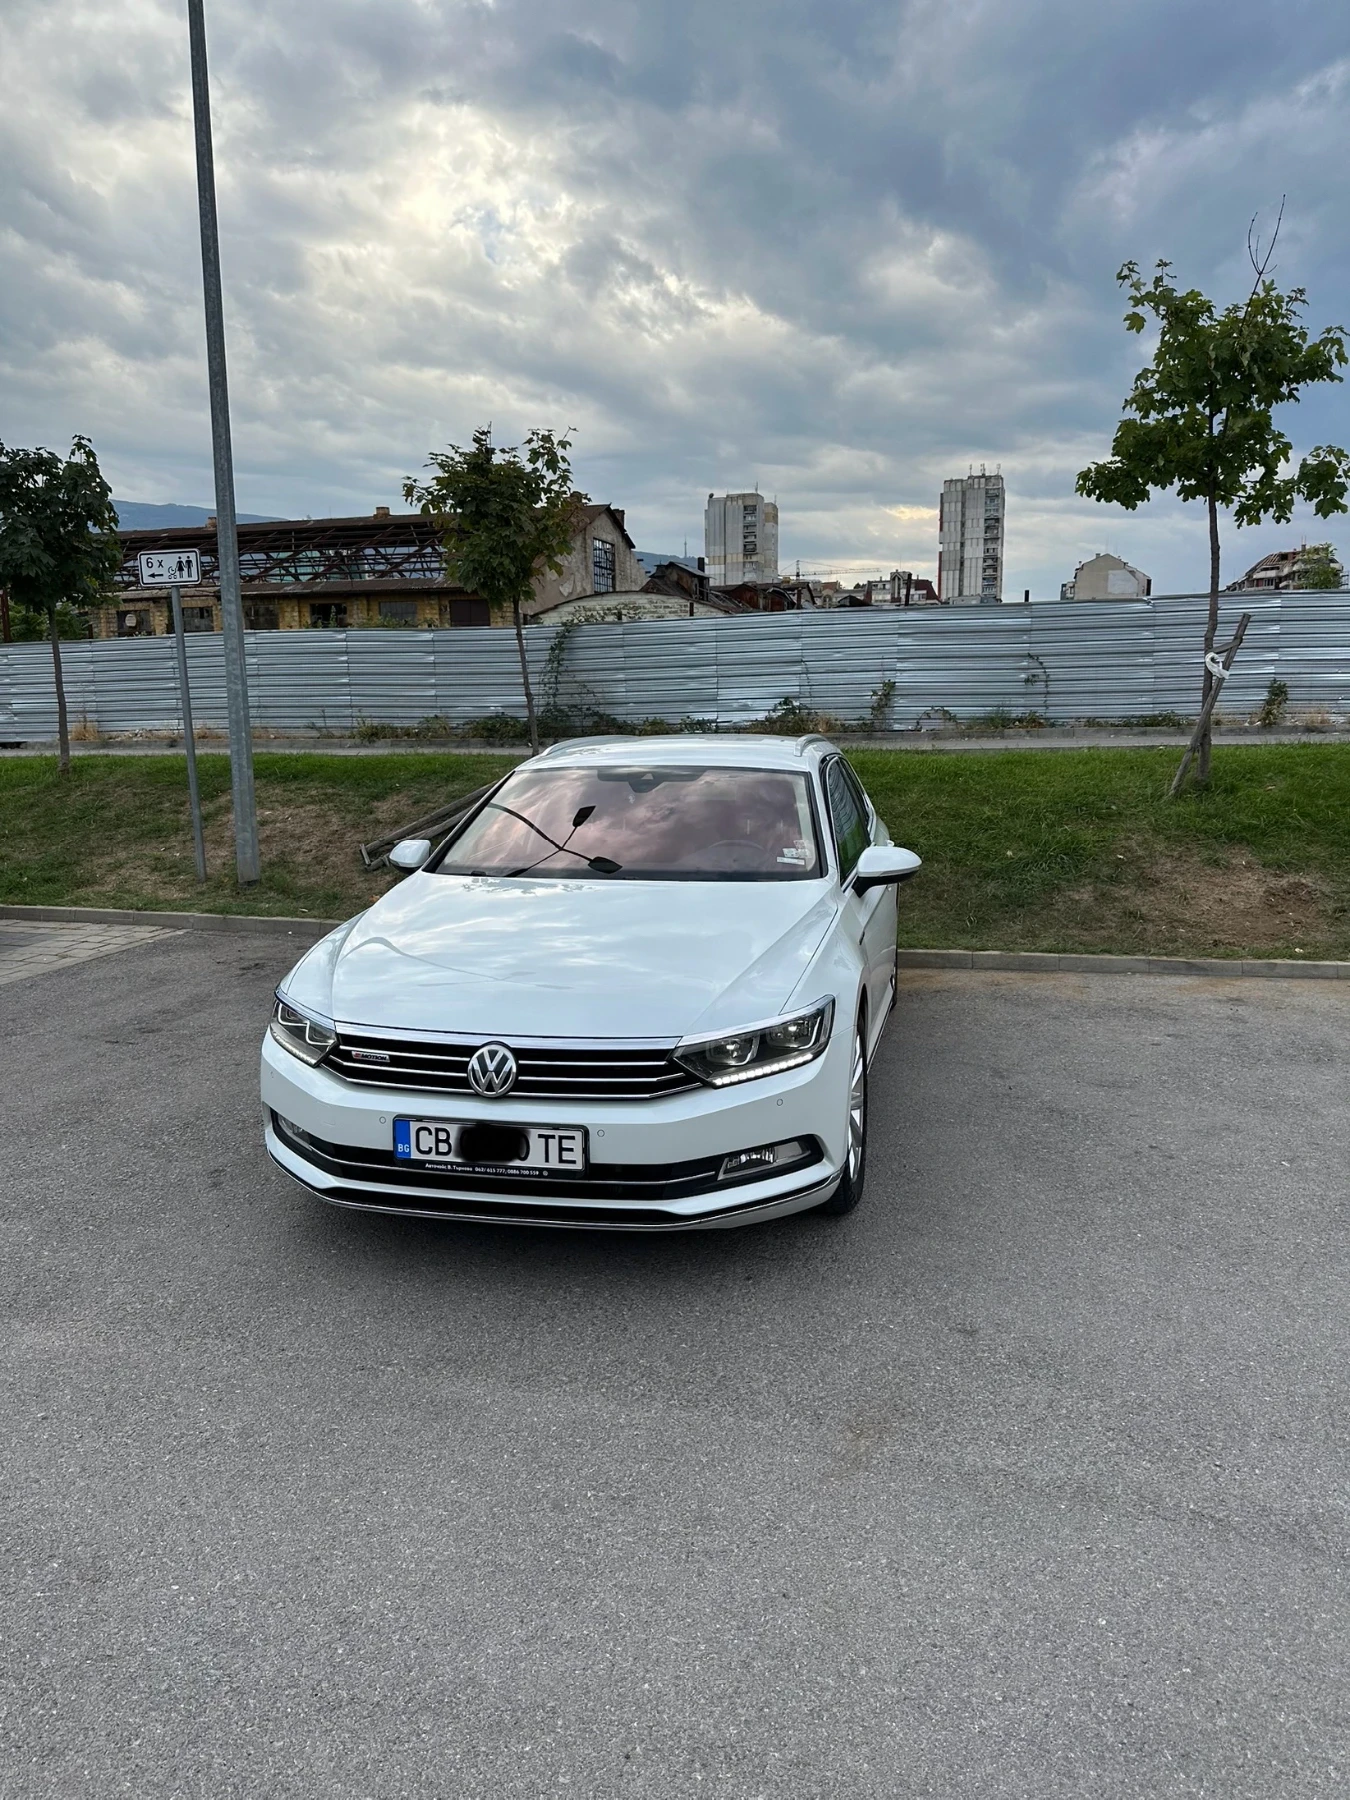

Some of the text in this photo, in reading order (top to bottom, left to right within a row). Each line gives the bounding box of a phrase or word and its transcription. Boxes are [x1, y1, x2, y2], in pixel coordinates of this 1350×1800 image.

[146, 557, 153, 568] 6
[471, 1045, 514, 1095] VW
[397, 1143, 410, 1153] BG
[415, 1126, 452, 1156] CB
[537, 1133, 577, 1164] TE
